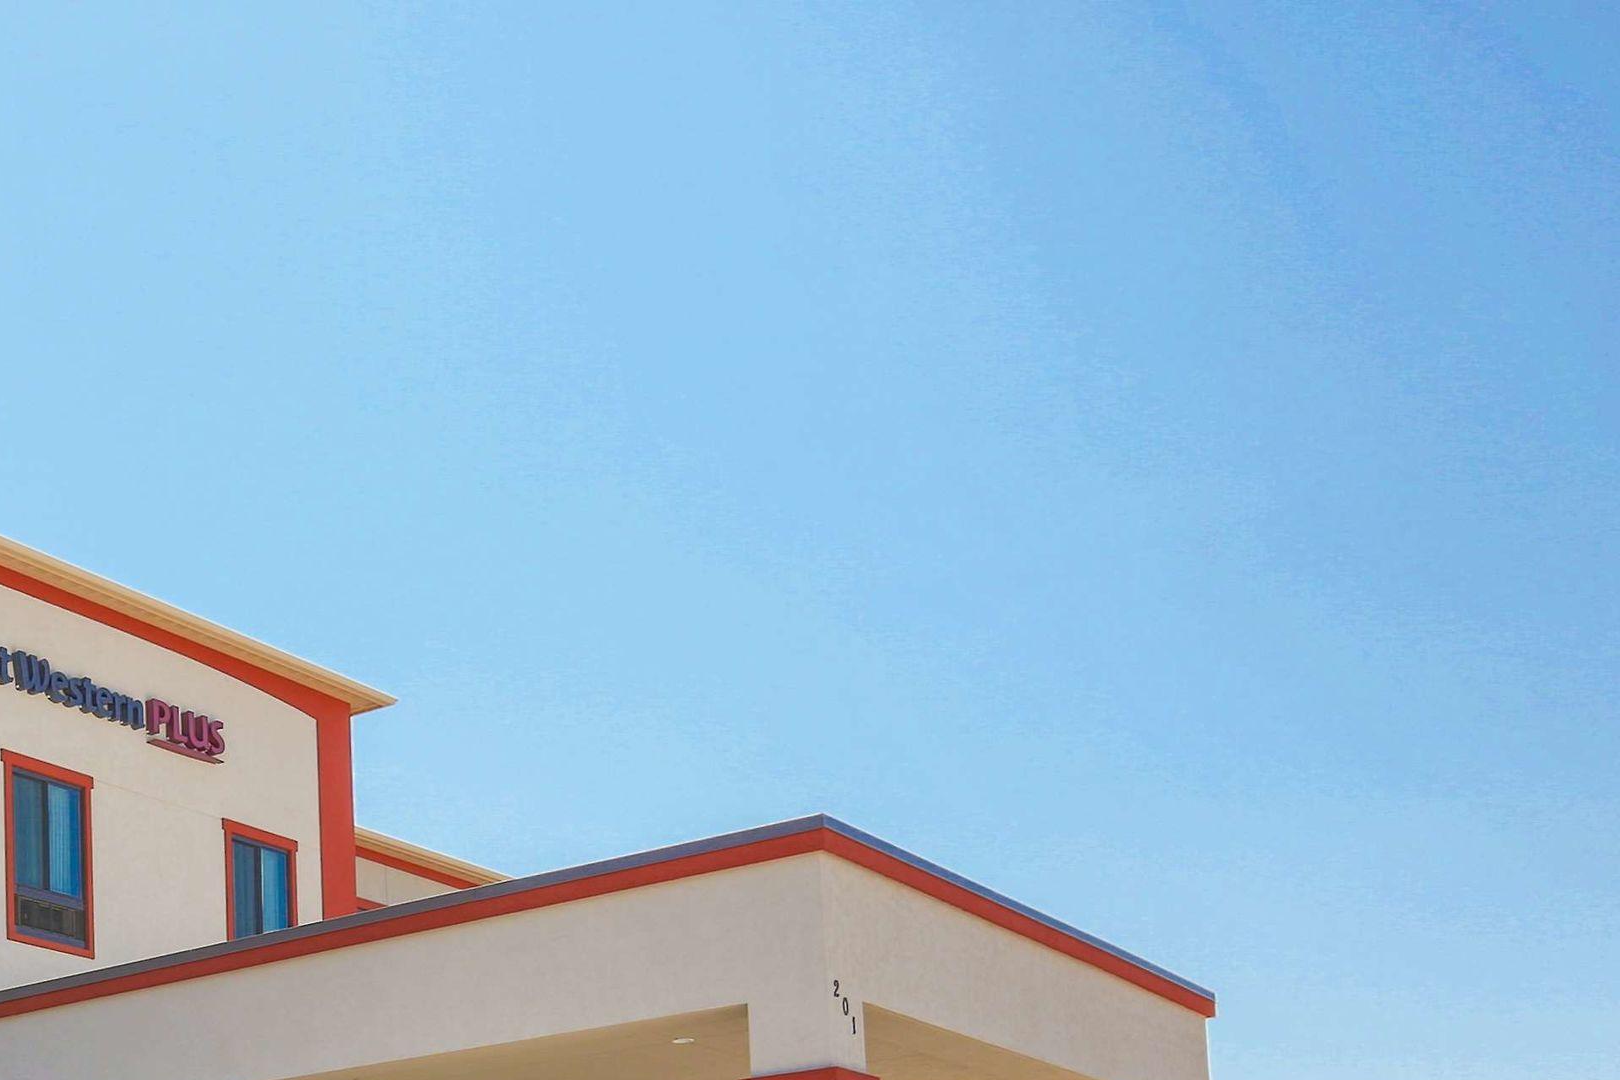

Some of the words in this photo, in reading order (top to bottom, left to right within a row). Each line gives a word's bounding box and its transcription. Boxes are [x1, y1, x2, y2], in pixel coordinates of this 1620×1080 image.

[13, 649, 145, 730] Western
[145, 698, 226, 756] PLUS
[833, 980, 856, 1034] 201
